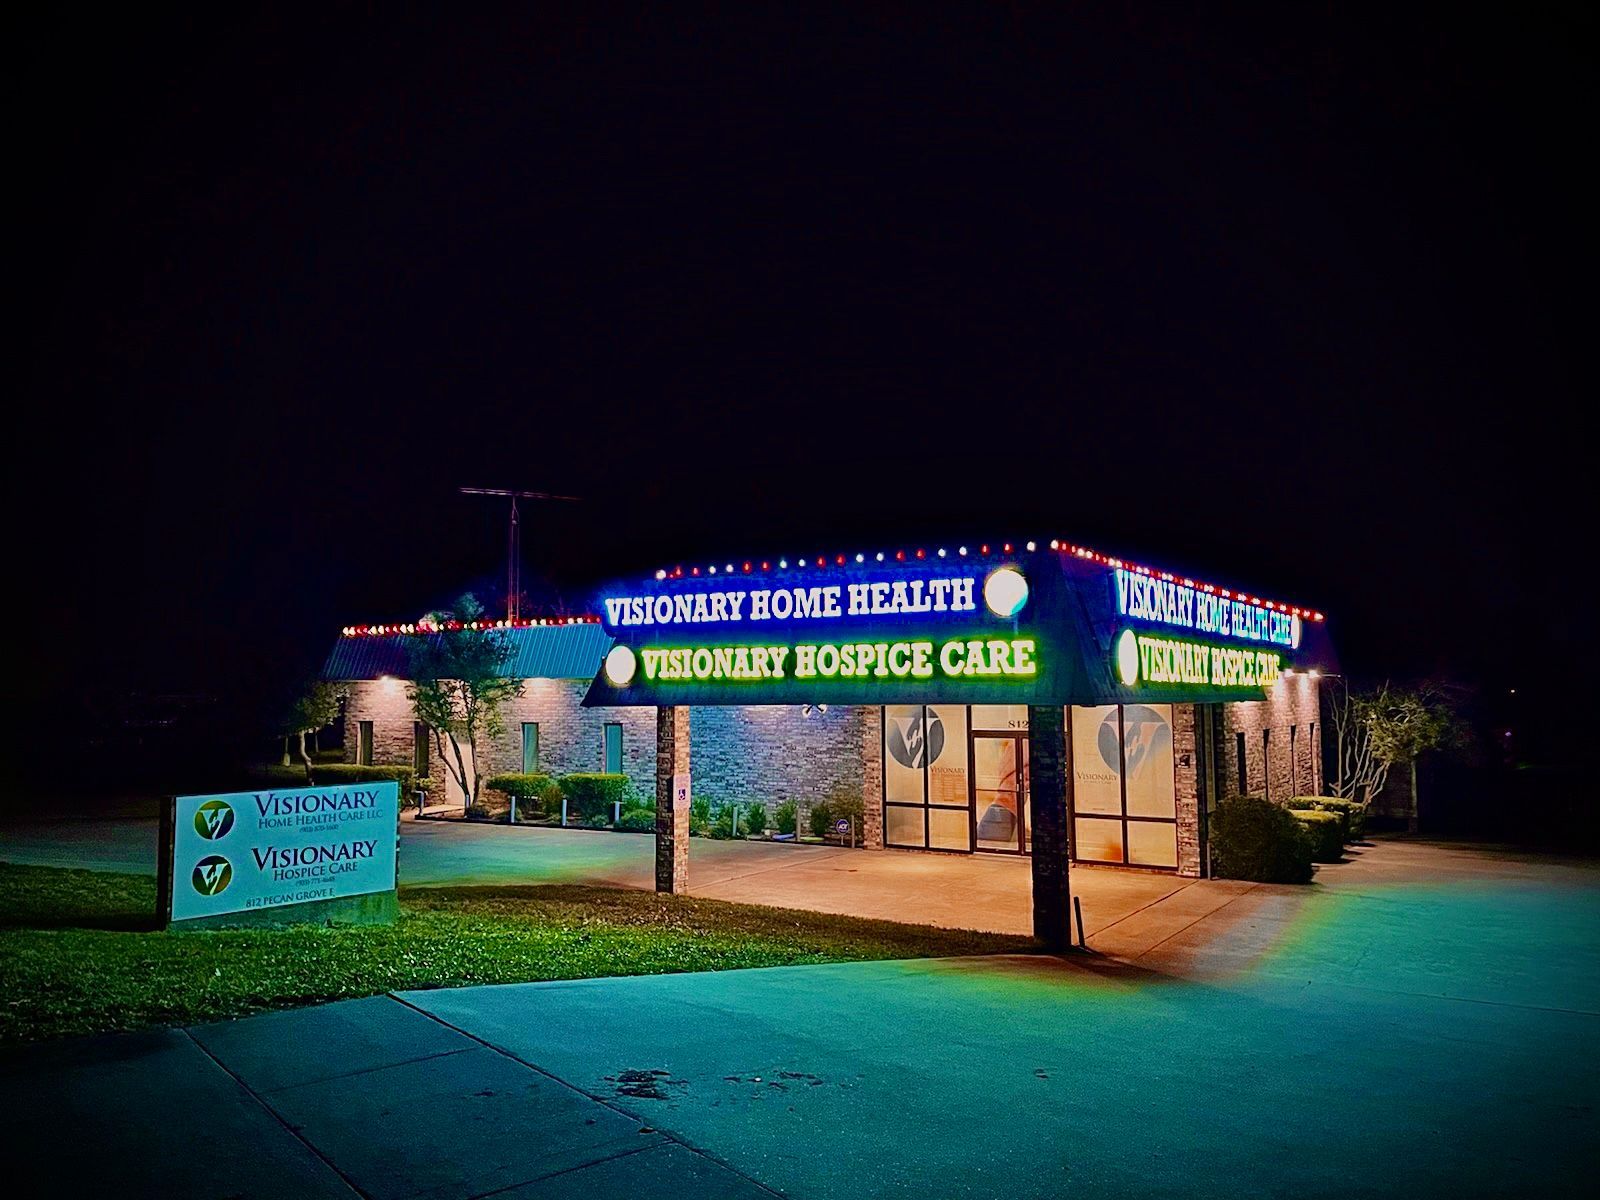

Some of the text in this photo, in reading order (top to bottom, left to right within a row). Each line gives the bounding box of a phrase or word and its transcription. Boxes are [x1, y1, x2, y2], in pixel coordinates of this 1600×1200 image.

[605, 577, 975, 626] VISIONARY HOME HEALTH
[1116, 569, 1194, 627] VISIONARY
[1196, 591, 1230, 635] HOME
[1232, 602, 1269, 641] HEALTH
[641, 640, 1036, 679] VISIONARY HOSPICE CARE
[1138, 636, 1210, 684] VISIONARY
[1211, 648, 1255, 686] HOSPICE
[1008, 719, 1029, 728] 812
[1077, 771, 1117, 781] VISIONARY
[255, 791, 379, 816] VISIONARY
[258, 809, 383, 829] HOME HEALTH CARE LLC
[251, 840, 378, 871] VISIONARY
[273, 865, 326, 881] HOSPICE
[328, 861, 358, 873] CARE
[246, 897, 261, 908] 812
[263, 893, 294, 905] PECAN
[296, 888, 327, 901] GROVE
